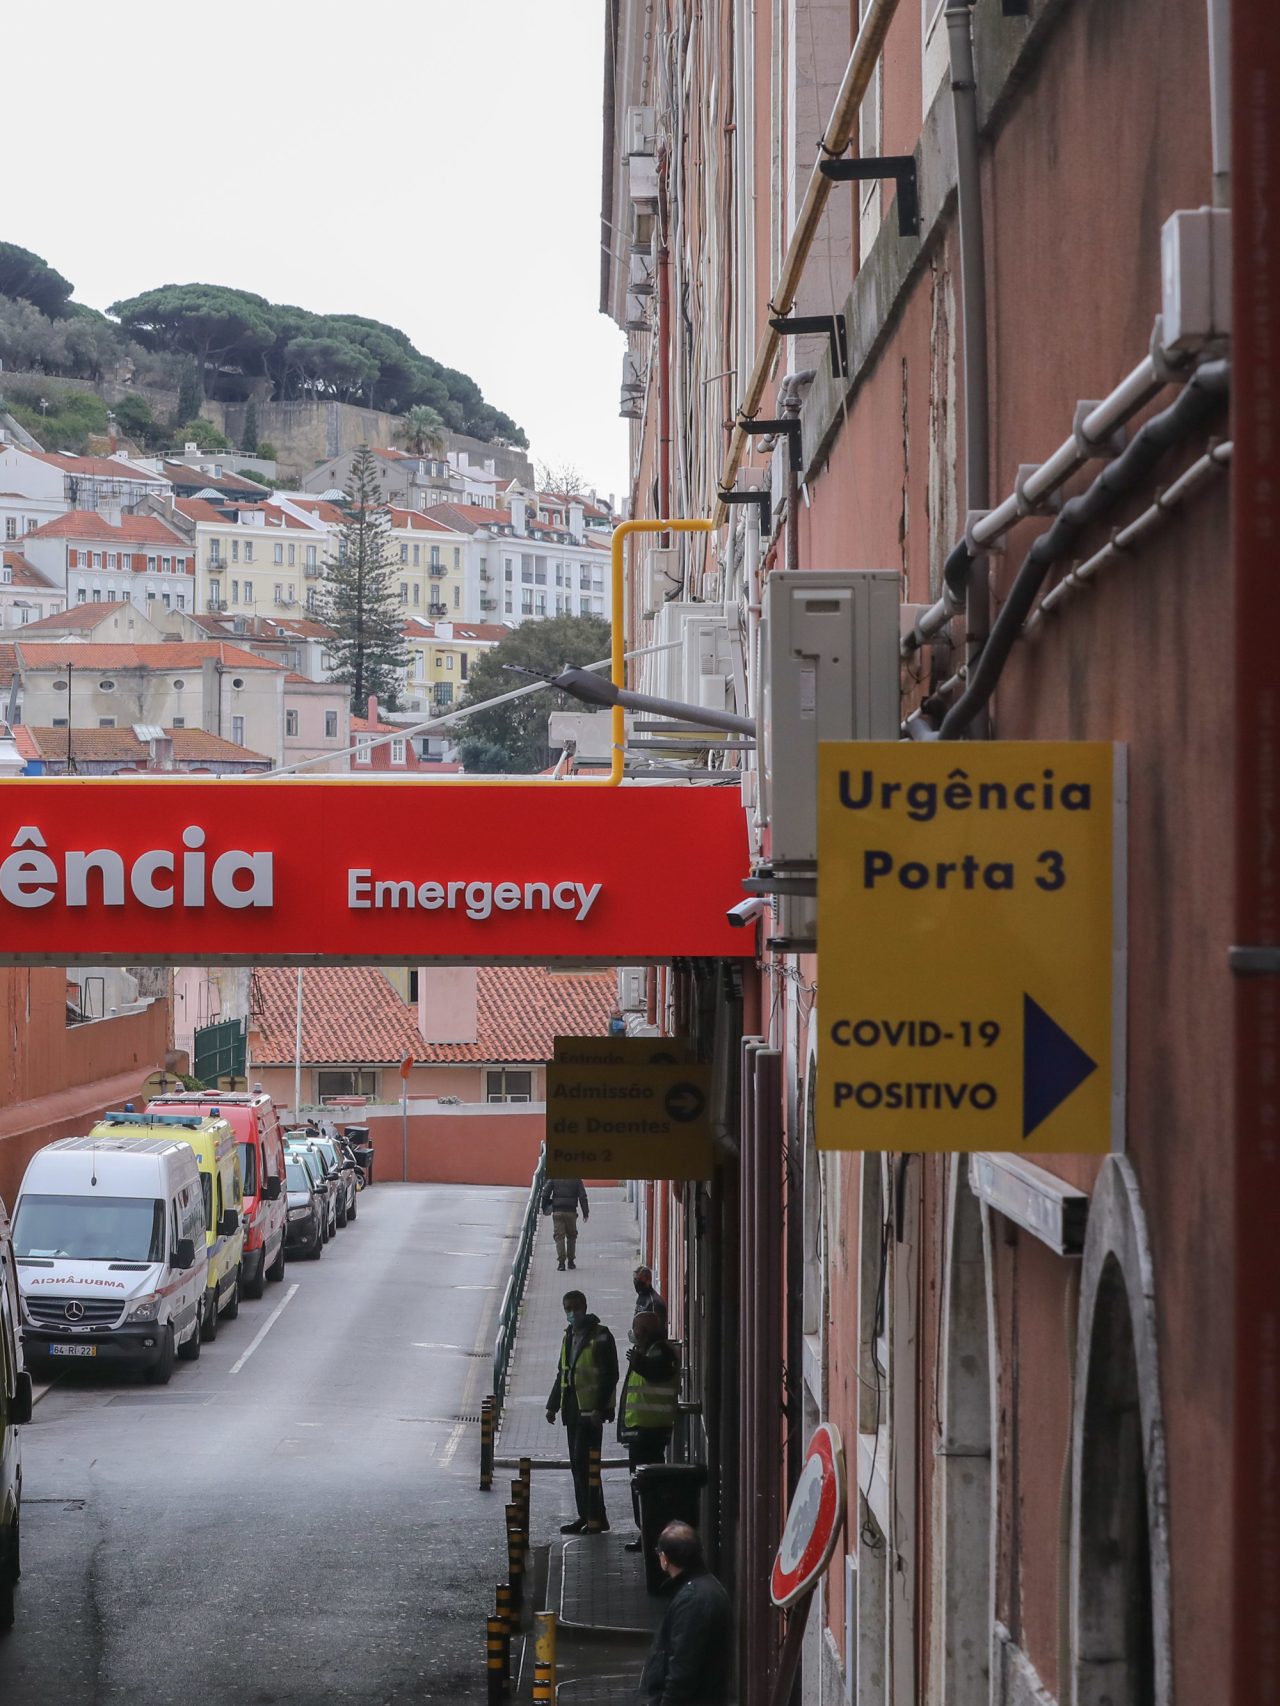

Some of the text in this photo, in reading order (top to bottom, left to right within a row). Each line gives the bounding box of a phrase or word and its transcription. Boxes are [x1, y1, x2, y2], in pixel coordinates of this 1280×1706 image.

[838, 768, 1091, 822] Urgência
[863, 850, 1066, 891] Porta 3
[348, 868, 602, 920] Emergency
[830, 1020, 1001, 1048] COVID-19
[553, 1083, 654, 1099] Admissão
[833, 1082, 998, 1110] POSITIVO
[553, 1118, 671, 1134] de Doentes
[554, 1149, 613, 1163] Porta 2
